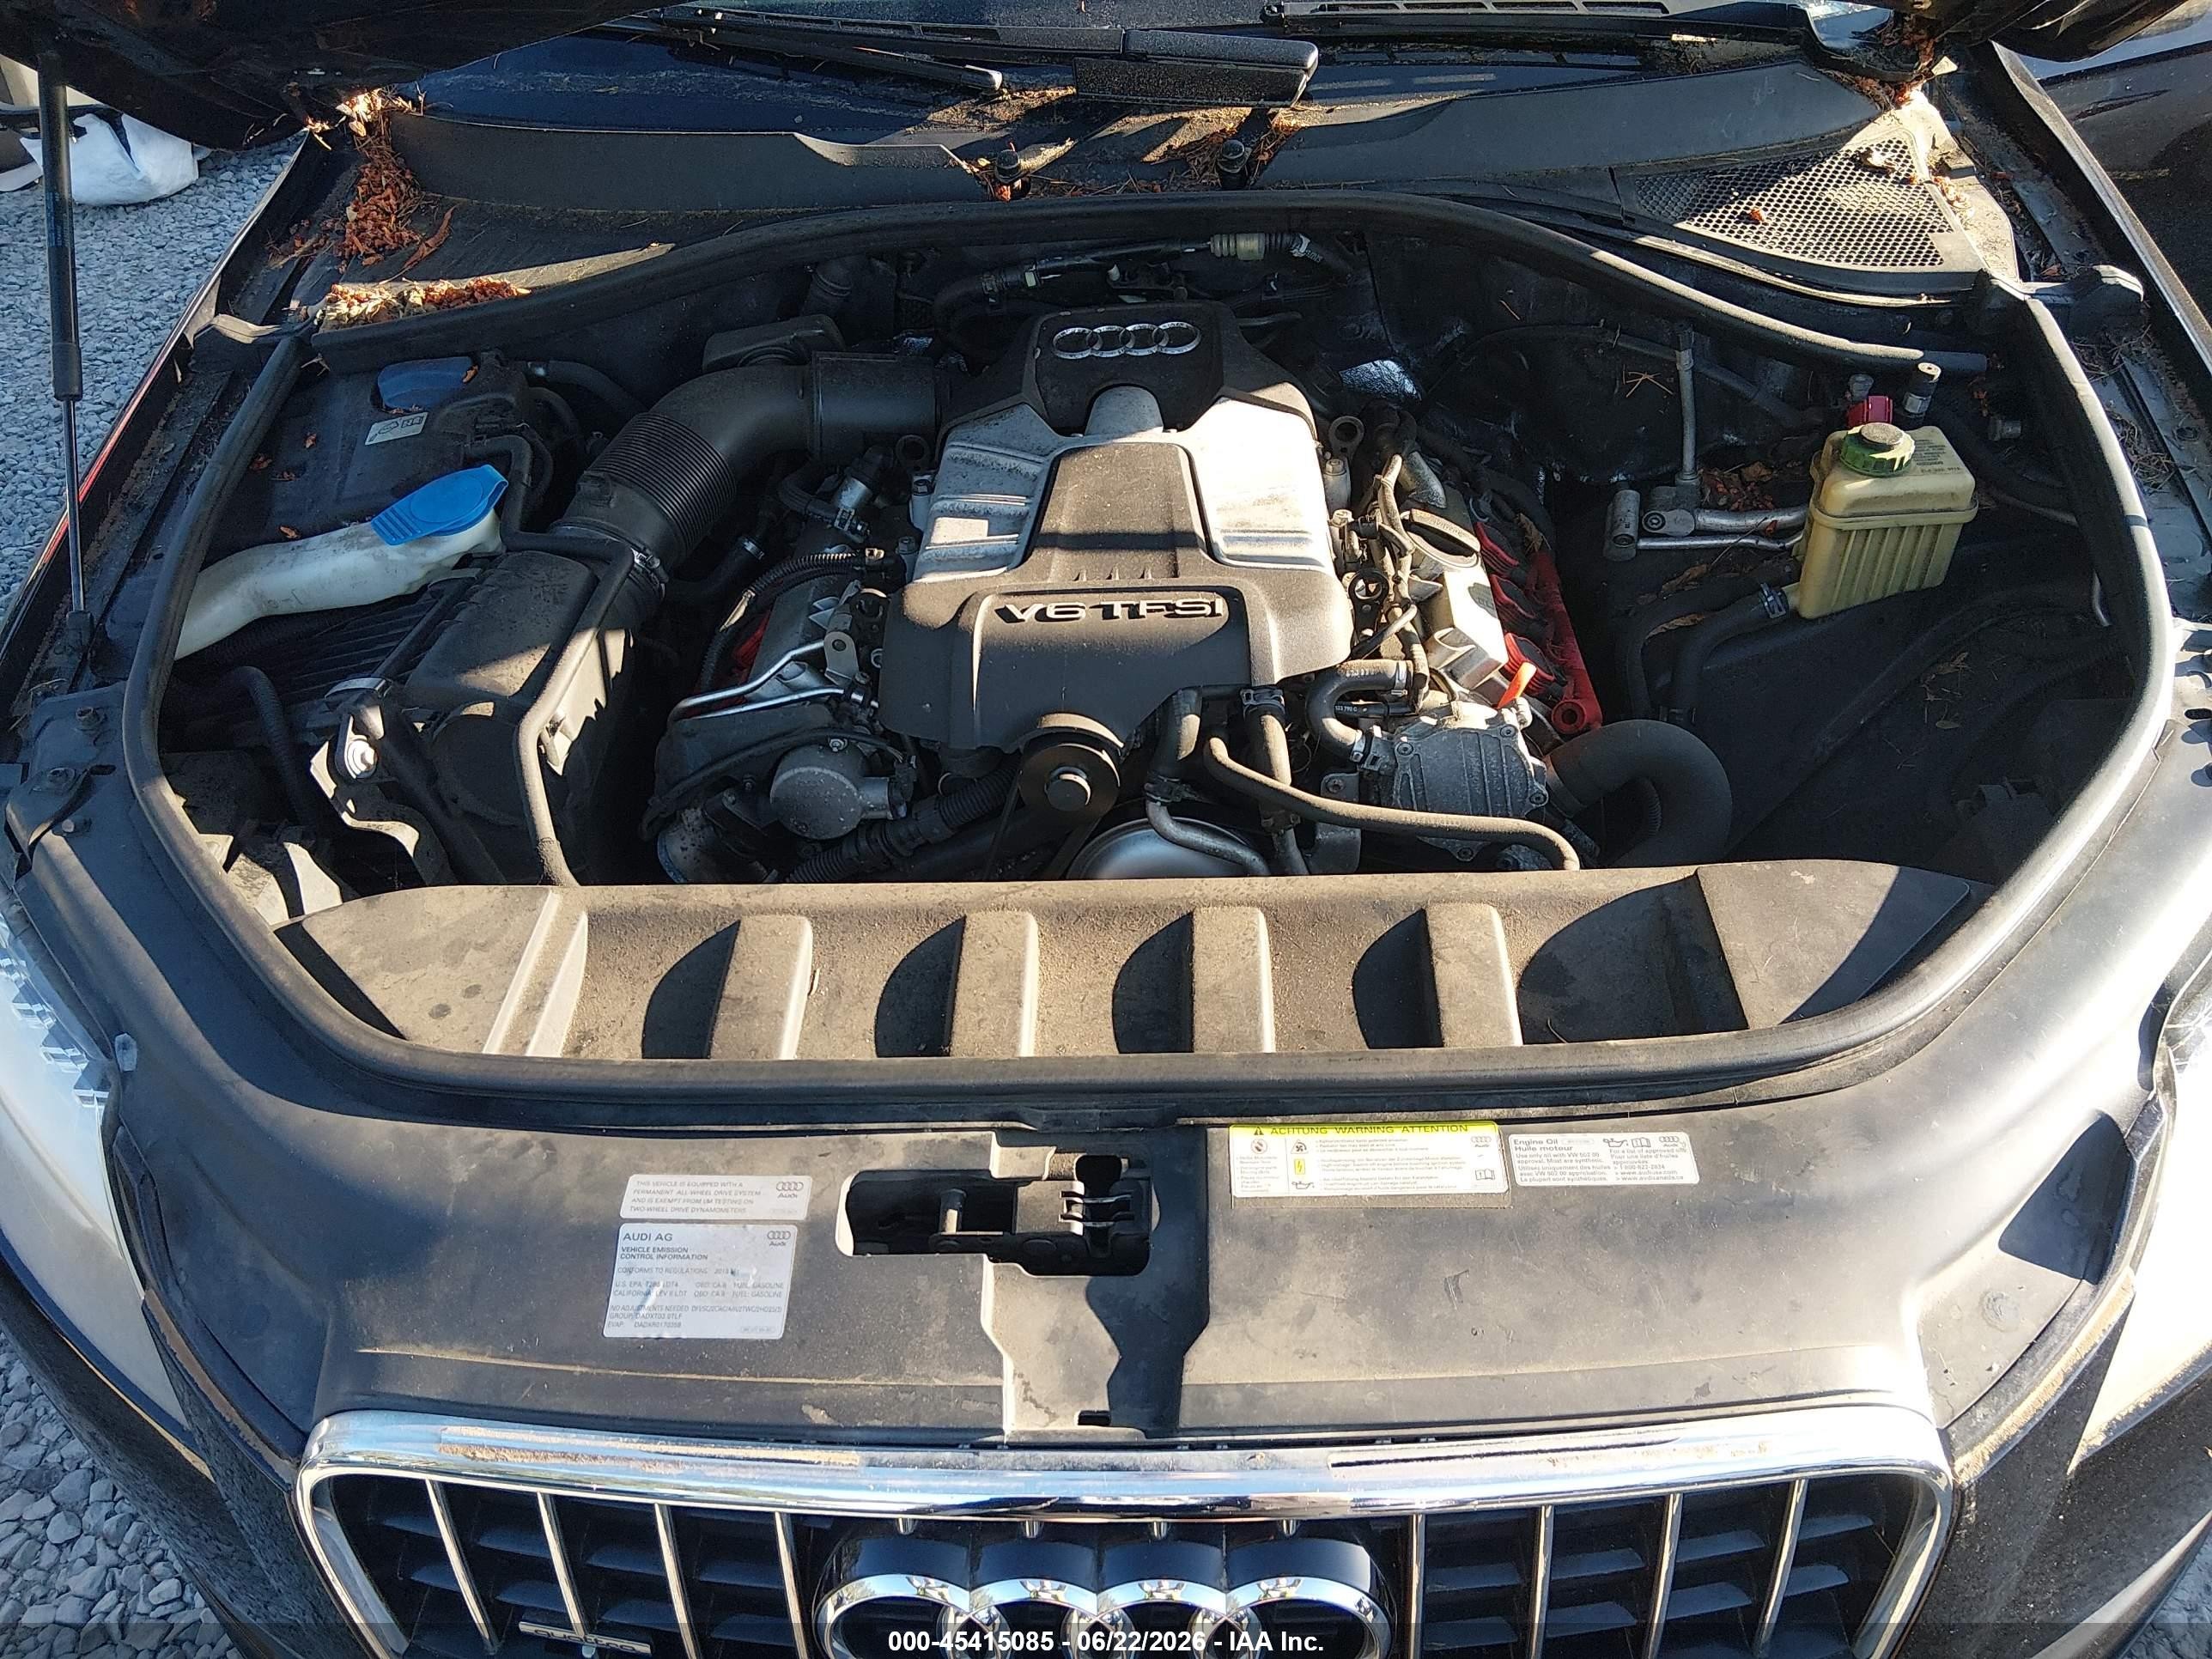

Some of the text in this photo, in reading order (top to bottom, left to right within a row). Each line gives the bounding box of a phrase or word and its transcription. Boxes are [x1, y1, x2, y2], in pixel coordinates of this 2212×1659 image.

[997, 599, 1223, 623] V6 TFSI
[1401, 1124, 1468, 1133] ATTENTION
[623, 1232, 673, 1242] AUDI AG
[534, 1629, 636, 1652] quattro
